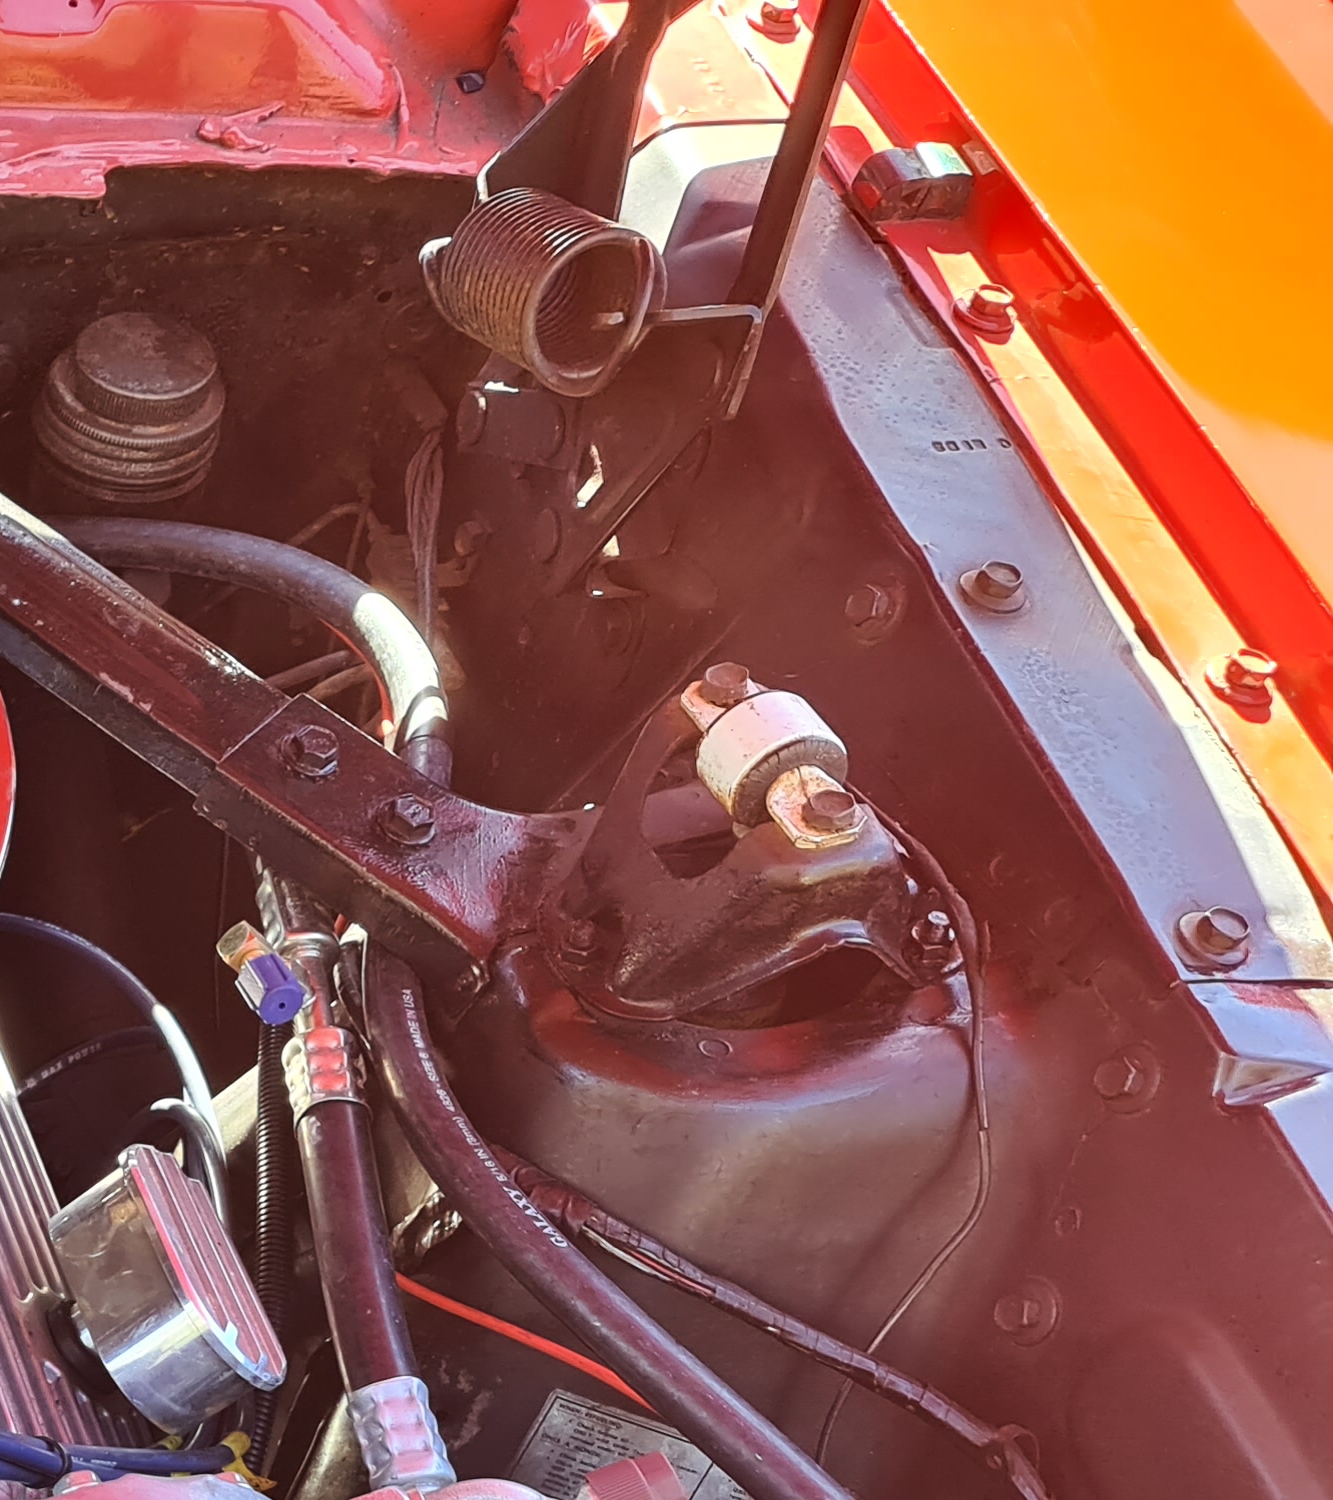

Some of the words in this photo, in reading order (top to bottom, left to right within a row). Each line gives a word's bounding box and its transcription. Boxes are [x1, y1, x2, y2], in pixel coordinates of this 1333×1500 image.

[401, 988, 414, 1008] USA
[404, 1007, 416, 1020] IN
[407, 1020, 426, 1049] MADE
[420, 1058, 440, 1082] SIZE
[474, 1146, 489, 1160] IN
[502, 1185, 568, 1248] GALAXY
